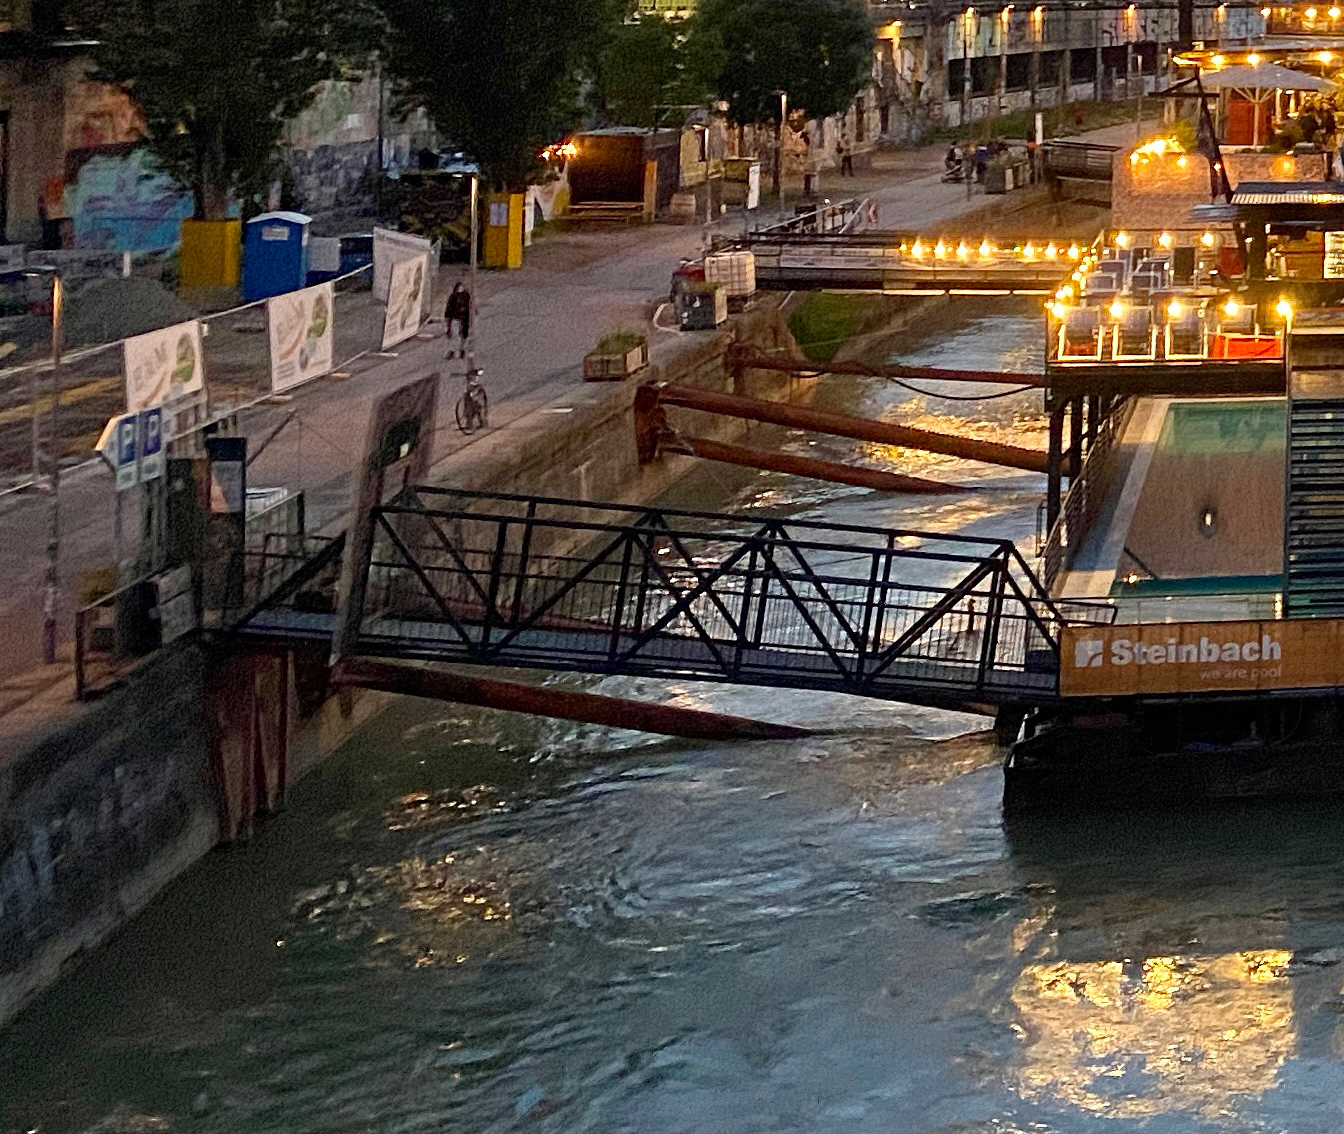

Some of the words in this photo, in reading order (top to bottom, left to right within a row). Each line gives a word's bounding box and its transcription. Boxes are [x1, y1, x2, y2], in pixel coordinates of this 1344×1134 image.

[1111, 634, 1282, 665] Steinbach
[1201, 669, 1221, 680] we
[1225, 667, 1249, 679] are
[1252, 664, 1282, 681] pool
